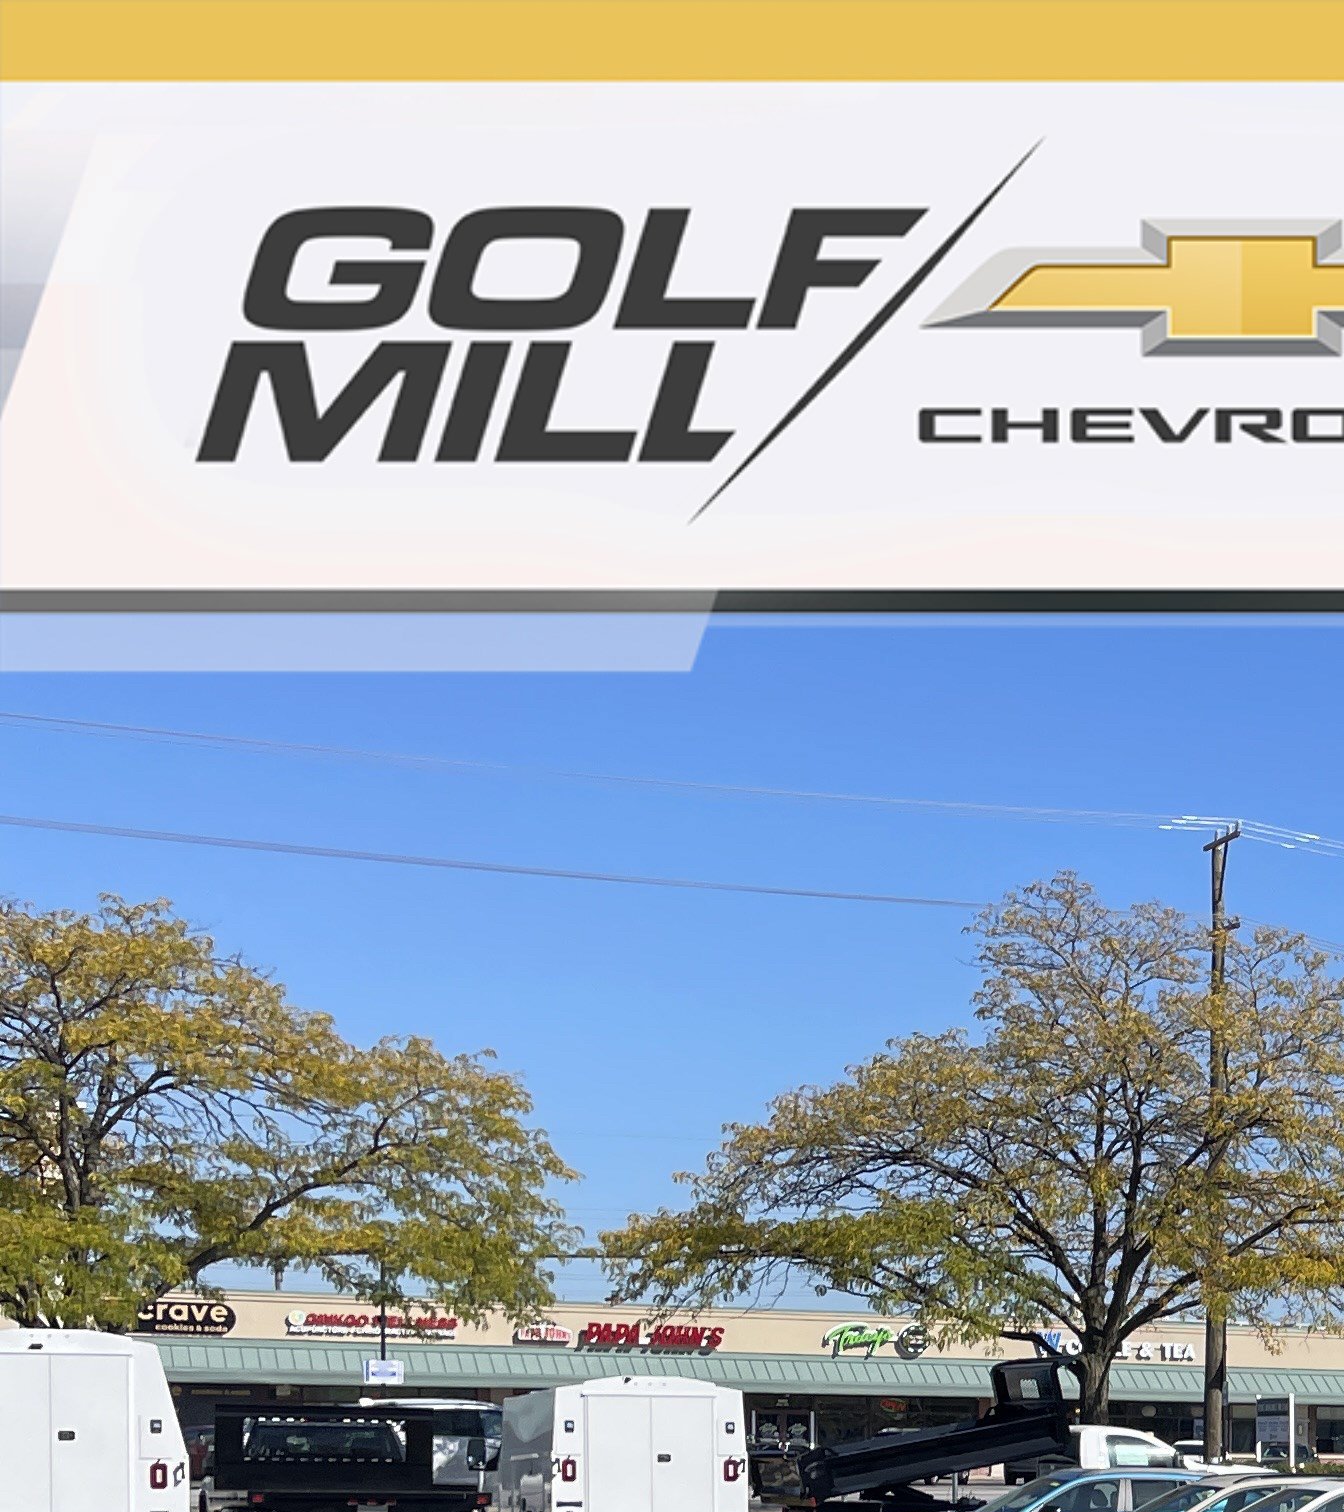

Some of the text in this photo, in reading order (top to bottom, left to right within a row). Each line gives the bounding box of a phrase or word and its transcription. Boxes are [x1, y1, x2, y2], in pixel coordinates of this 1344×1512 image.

[155, 1323, 194, 1332] cookies
[204, 1325, 228, 1333] soda
[586, 1322, 725, 1348] PAPA JOHN'S
[1139, 1343, 1154, 1359] &
[1163, 1343, 1196, 1360] TEA
